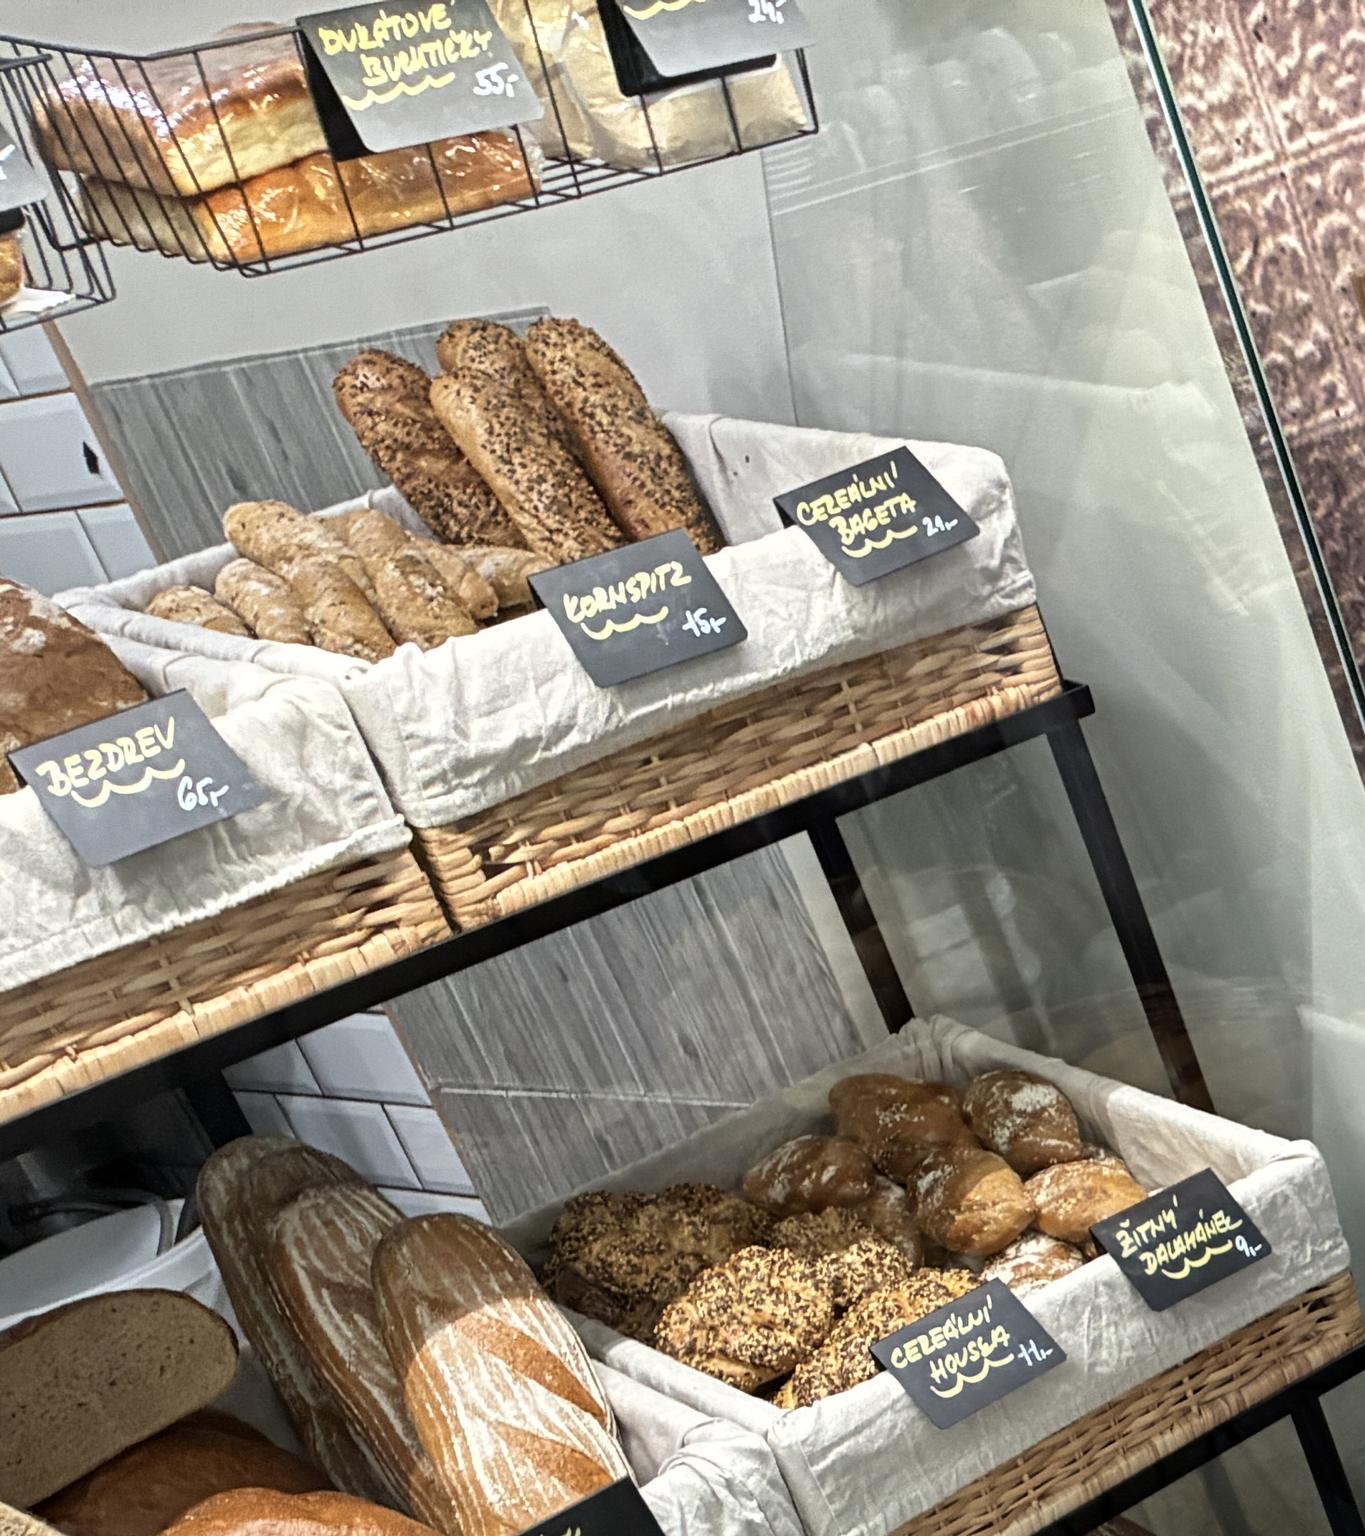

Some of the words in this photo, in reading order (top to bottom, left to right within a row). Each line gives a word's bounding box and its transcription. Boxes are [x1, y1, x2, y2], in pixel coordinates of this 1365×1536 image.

[473, 62, 520, 98] 55,-
[828, 492, 917, 546] BAGETA
[563, 560, 692, 624] KORNSPITZ
[35, 716, 175, 797] BEZDREV
[177, 775, 230, 811] 65,-
[1115, 1194, 1178, 1259] ŽITNÝ
[1234, 1235, 1263, 1257] 9,-
[929, 1325, 1011, 1384] HOUSKA
